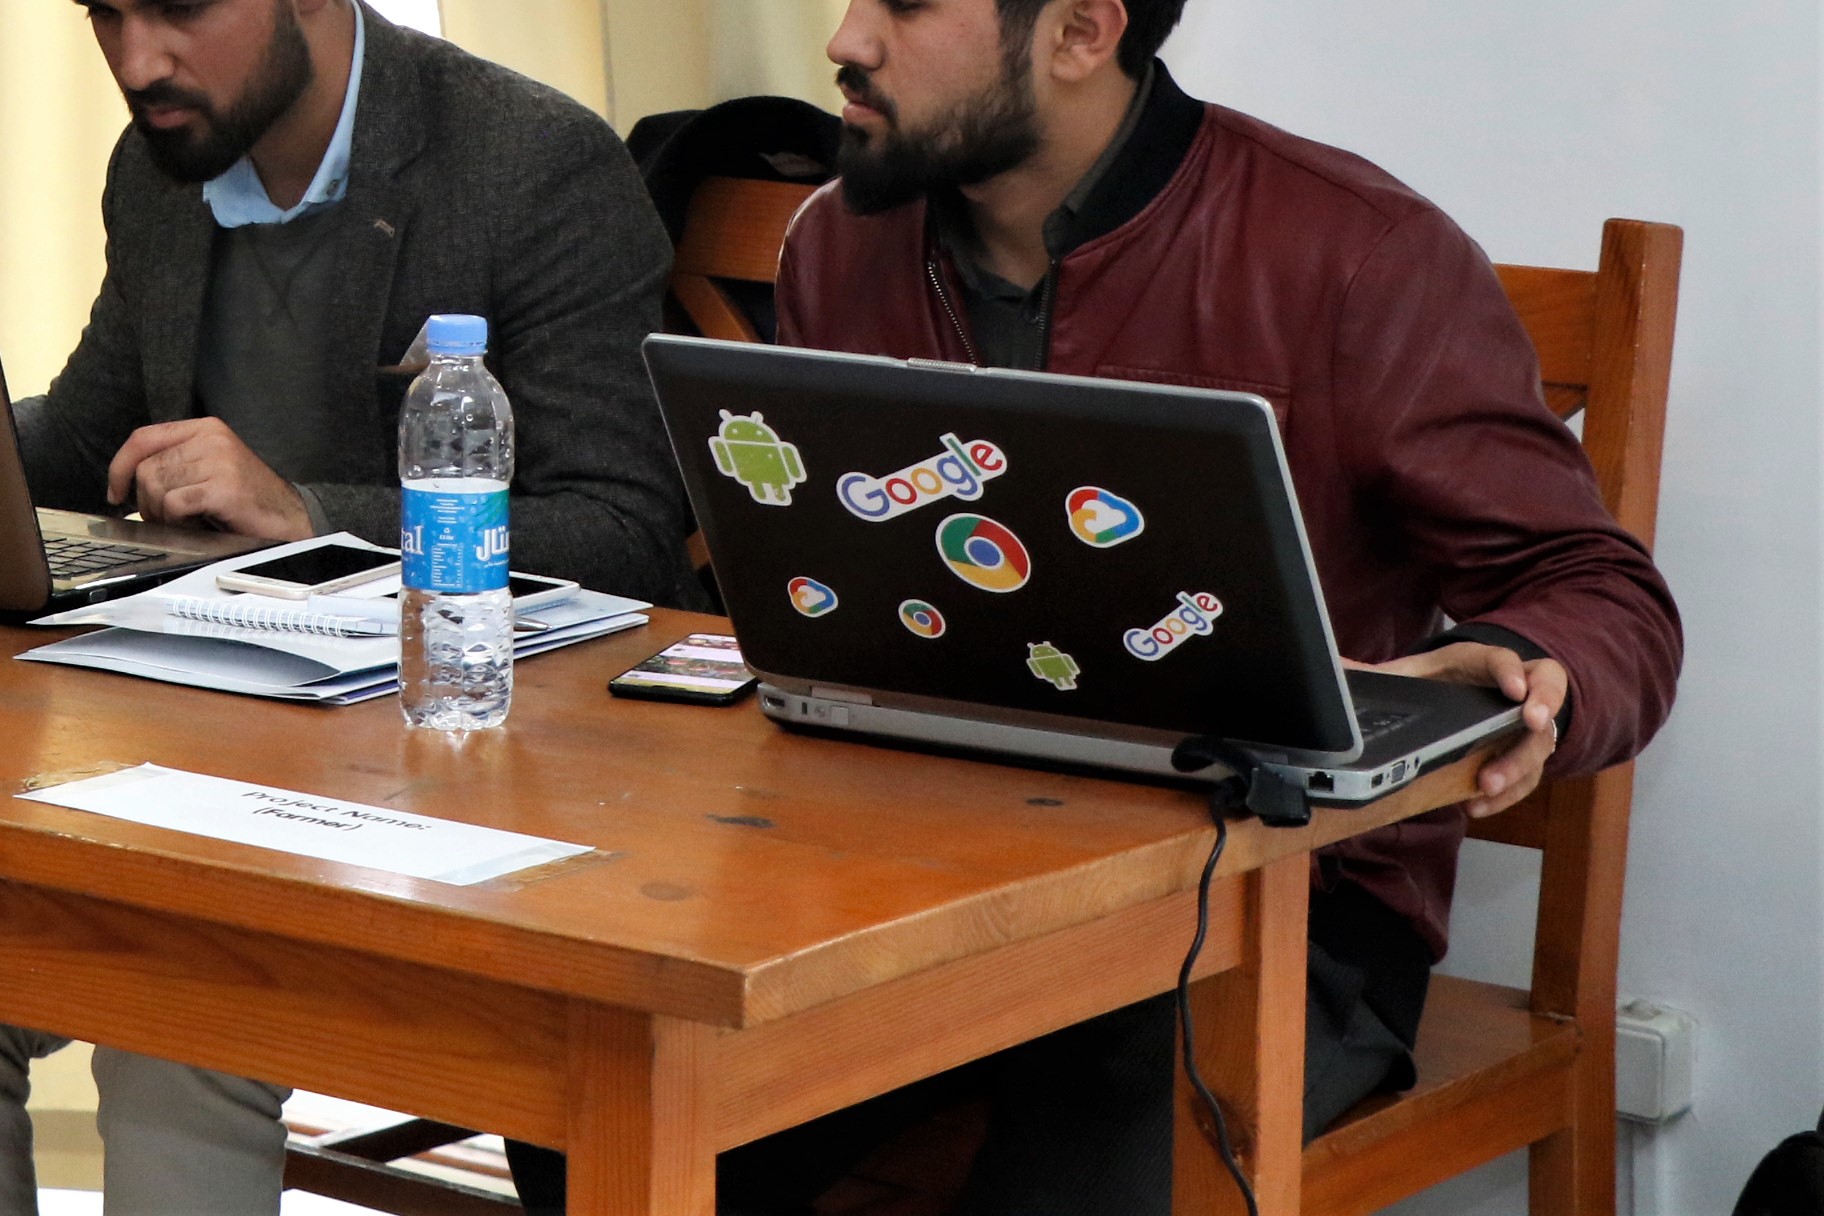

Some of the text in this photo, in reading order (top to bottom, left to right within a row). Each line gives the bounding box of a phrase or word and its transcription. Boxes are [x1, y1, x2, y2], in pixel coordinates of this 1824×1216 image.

[841, 437, 1004, 517] Google
[1127, 595, 1219, 657] Google
[241, 791, 432, 831] Project Name:
